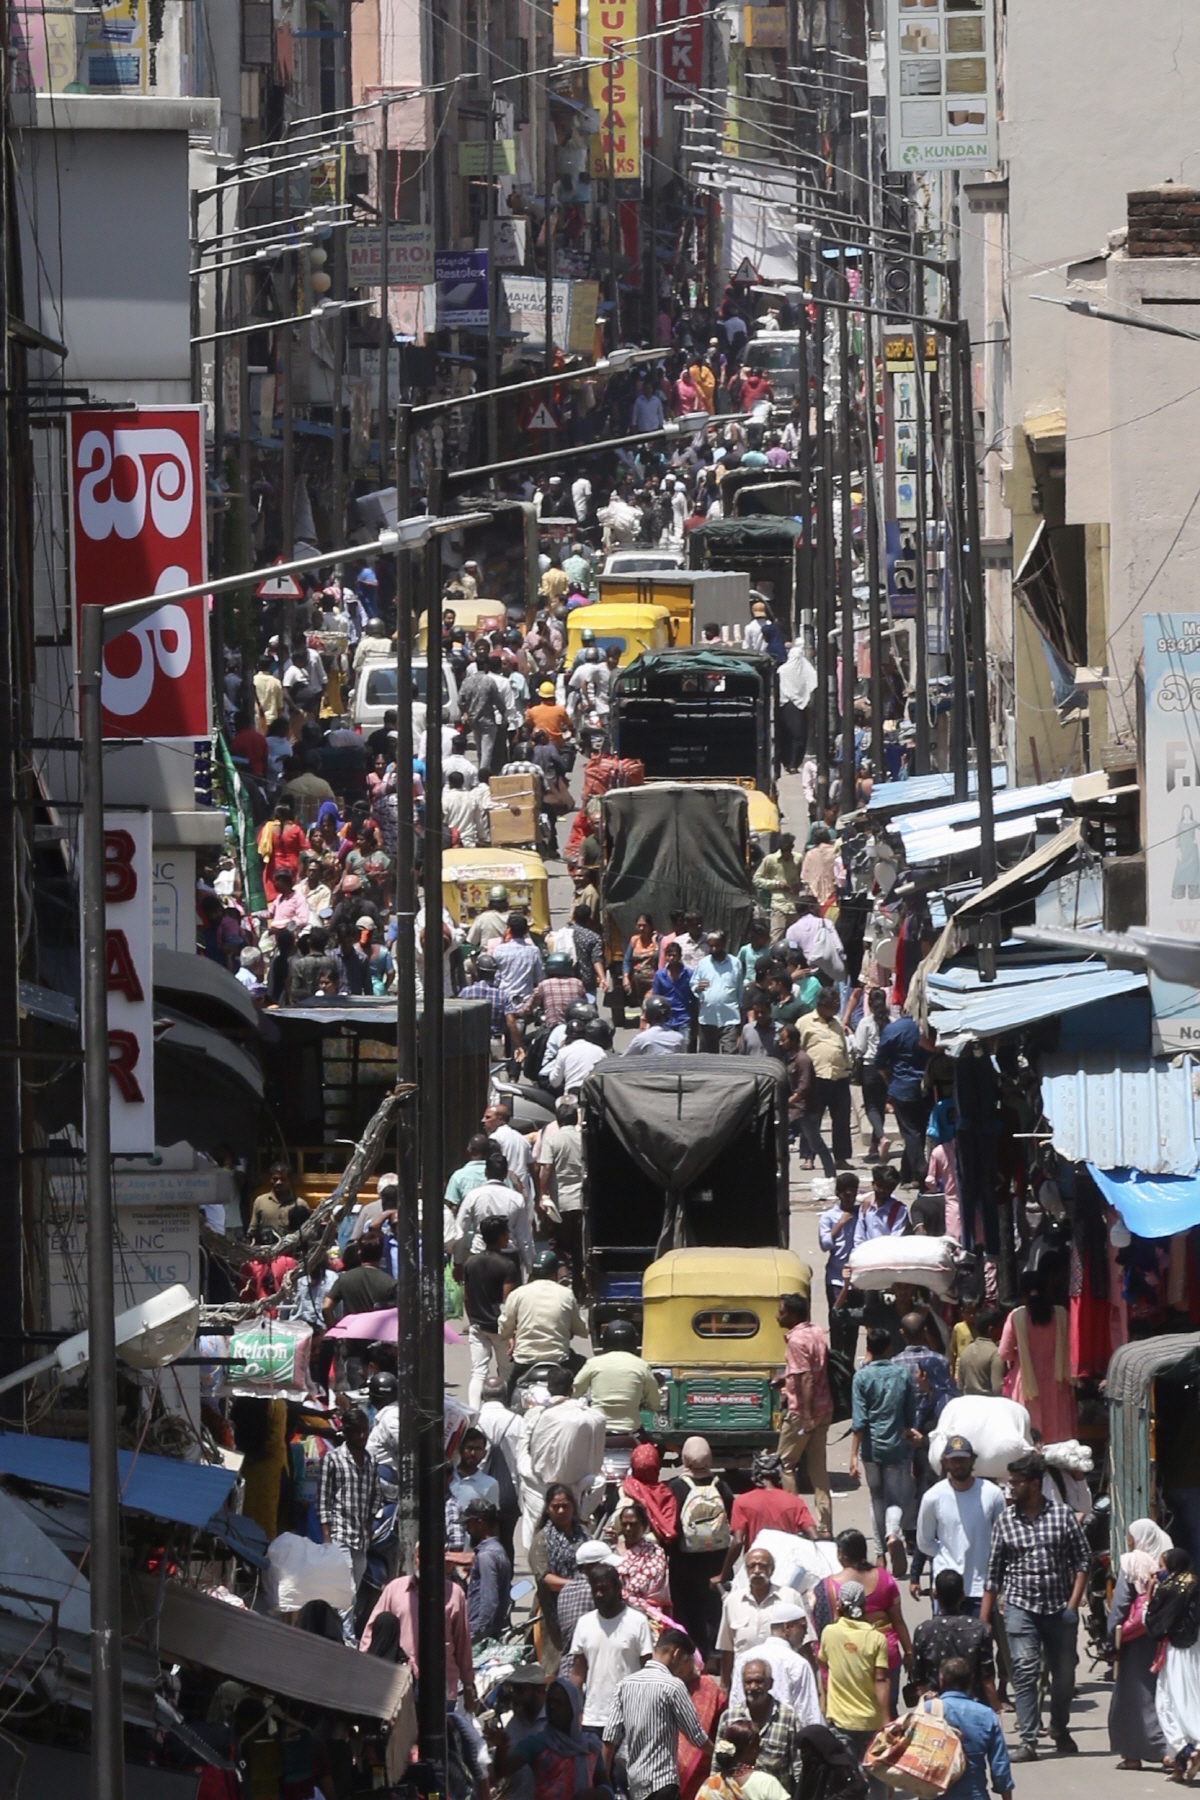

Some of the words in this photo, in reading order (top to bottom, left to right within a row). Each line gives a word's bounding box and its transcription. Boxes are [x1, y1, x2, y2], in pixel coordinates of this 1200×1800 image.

[600, 0, 627, 153] URUGAN
[924, 145, 987, 158] KUNDAN
[594, 158, 635, 174] SIKS
[436, 267, 486, 279] Restolex
[104, 829, 145, 1104] BAR
[135, 1235, 165, 1249] INC
[145, 1266, 176, 1281] NLS
